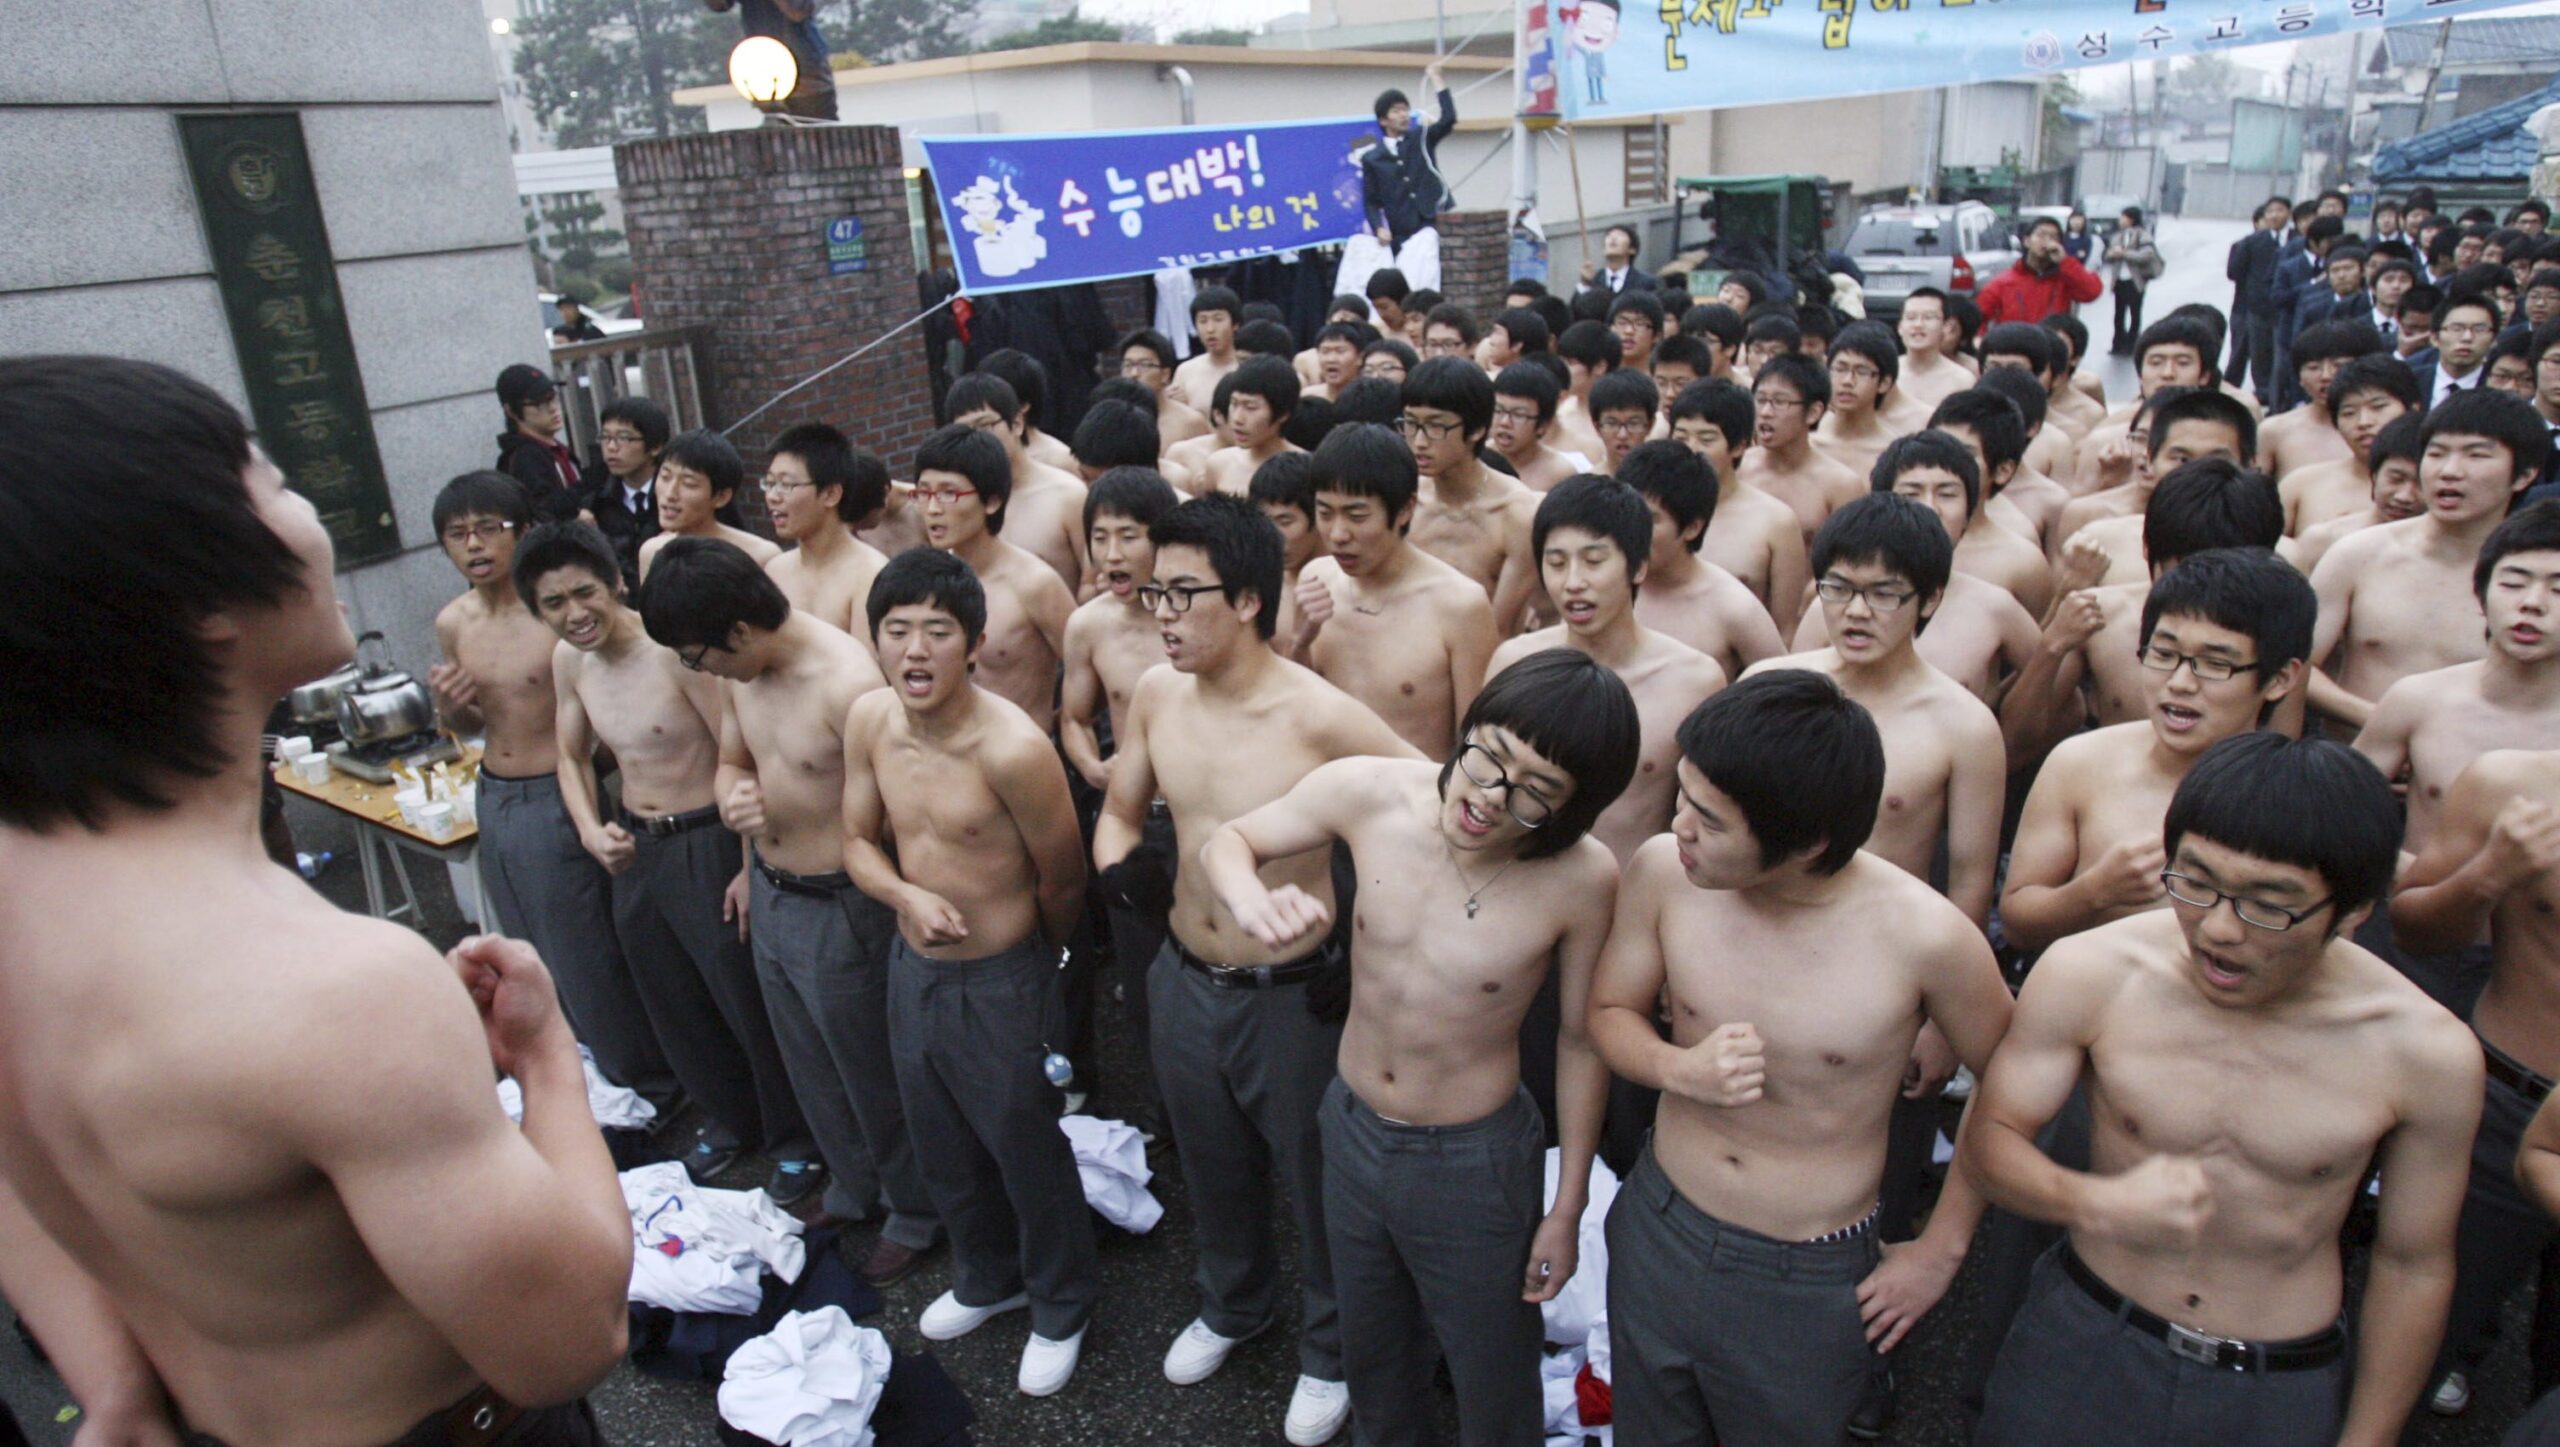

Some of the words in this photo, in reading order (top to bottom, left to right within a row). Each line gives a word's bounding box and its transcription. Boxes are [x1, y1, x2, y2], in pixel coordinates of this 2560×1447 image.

[1213, 203, 1277, 233] 나의
[1285, 191, 1321, 232] 것
[834, 219, 854, 240] 47
